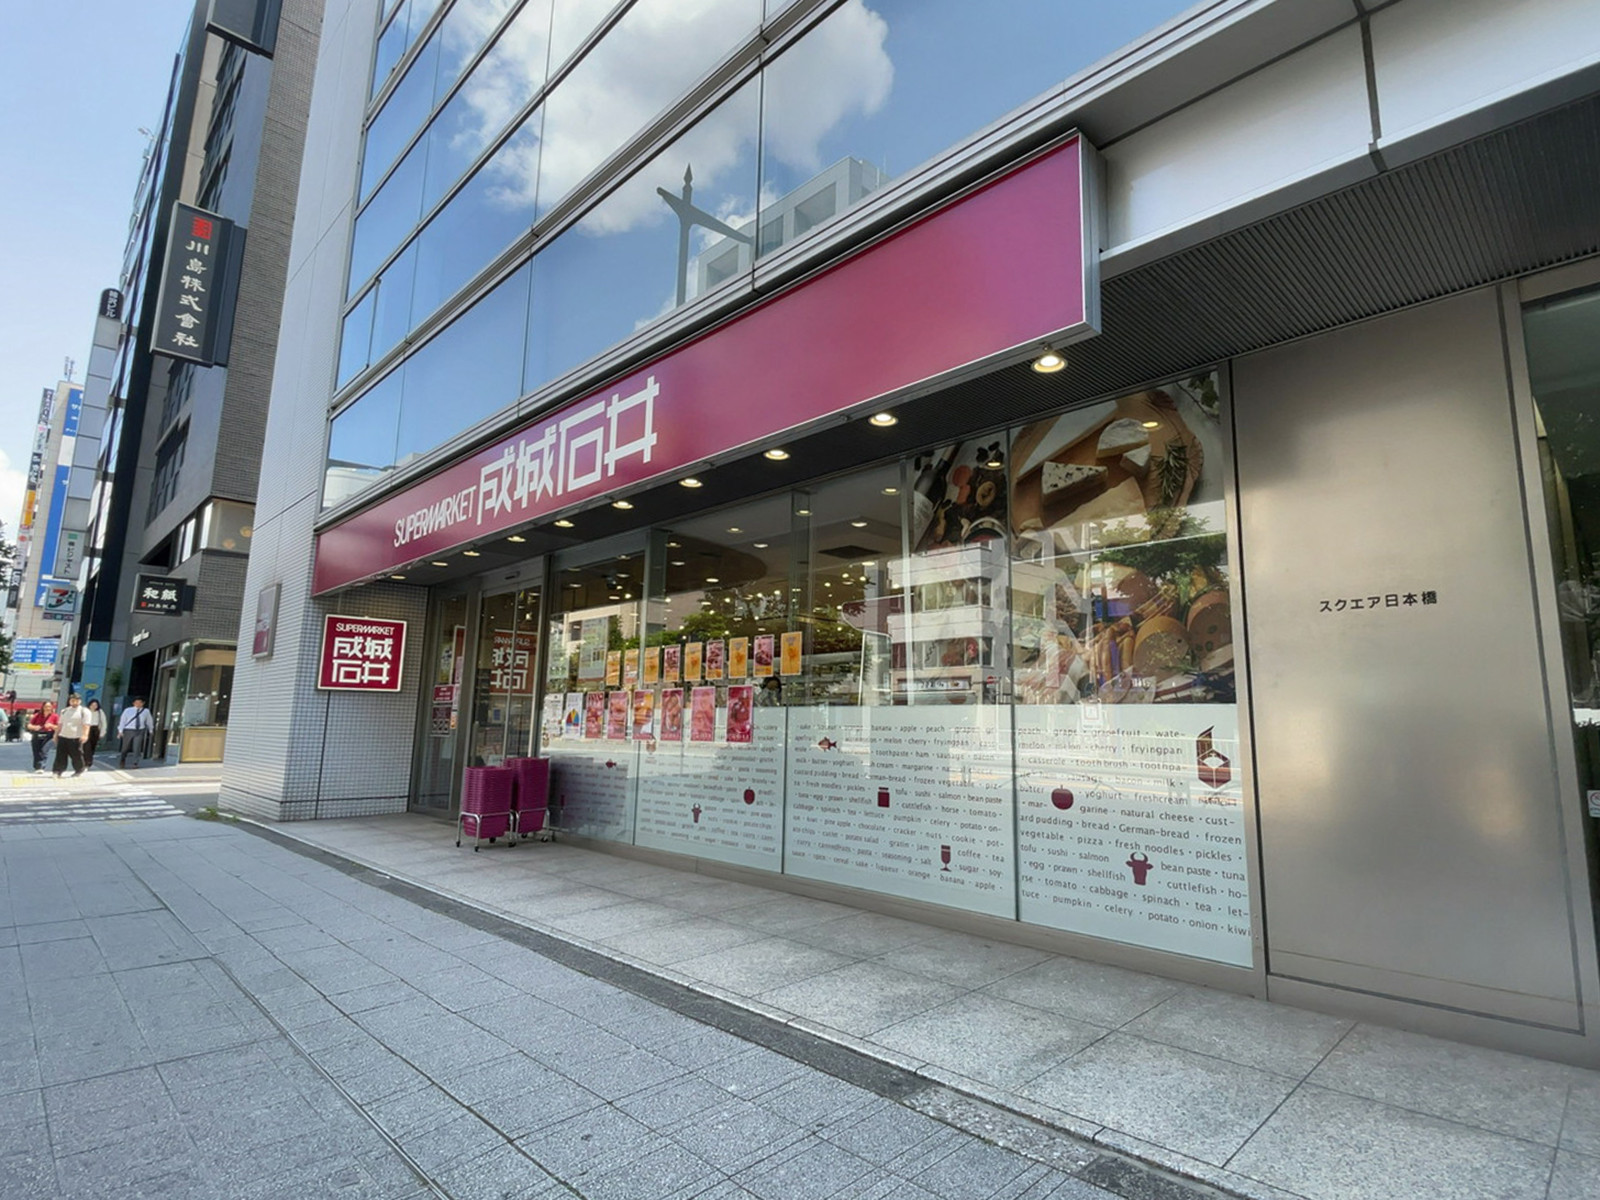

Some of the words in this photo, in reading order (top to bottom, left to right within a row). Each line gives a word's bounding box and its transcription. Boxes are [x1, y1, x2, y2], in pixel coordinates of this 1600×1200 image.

[170, 240, 210, 348] 川島株式會社
[393, 484, 477, 548] SUPERMARKET
[476, 375, 661, 527] 成城石井
[1319, 590, 1438, 613] スクエア日本橋
[335, 622, 396, 636] SUPERMARKET
[333, 635, 394, 661] 成城
[331, 659, 391, 685] 石井
[915, 750, 930, 758] ham
[1131, 744, 1184, 756] fryingpan
[913, 776, 936, 785] frozen
[938, 792, 962, 801] salmon
[967, 793, 984, 802] bean
[941, 805, 960, 814] horse
[969, 808, 998, 818] tomato
[1080, 805, 1109, 816] garine
[1120, 808, 1155, 820] natural
[1158, 811, 1195, 824] cheese
[1205, 816, 1236, 827] cust-
[929, 818, 951, 828] celery
[960, 822, 983, 831] potato
[1035, 815, 1074, 829] pudding
[1081, 819, 1110, 831] bread
[1118, 823, 1190, 840] German-bread
[1204, 831, 1243, 846] frozen
[892, 827, 917, 836] cracker
[950, 834, 977, 845] cookie
[1020, 829, 1065, 842] vegetable
[1077, 835, 1104, 846] pizza
[1114, 838, 1141, 851] fresh
[1144, 843, 1185, 857] noodles
[1195, 848, 1233, 863] pickles
[956, 849, 982, 859] coffee
[991, 854, 1005, 862] tea
[1020, 842, 1038, 853] tofu
[1047, 847, 1069, 858] sushi
[1078, 851, 1110, 863] salmon
[1160, 860, 1185, 874] bean
[1186, 866, 1212, 878] paste
[1221, 869, 1246, 882] tuna
[958, 863, 980, 874] sugar
[974, 880, 996, 891] apple
[1028, 860, 1046, 872] egg
[1053, 863, 1079, 875] prawn
[1087, 867, 1127, 882] shellfish
[1166, 879, 1218, 896] cuttlefish
[1228, 887, 1248, 900] ho-
[1021, 874, 1034, 883] rse
[1044, 877, 1078, 891] tomato
[1089, 883, 1129, 900] cabbage
[1141, 892, 1181, 907] spinach
[1194, 900, 1213, 913] tea
[1227, 905, 1249, 918] let-
[1021, 888, 1041, 900] tuce
[1052, 894, 1093, 909] pumpkin
[1104, 902, 1134, 918] celery
[1147, 911, 1180, 925] potato
[1188, 917, 1219, 932] onion
[1226, 922, 1252, 938] kiwi
